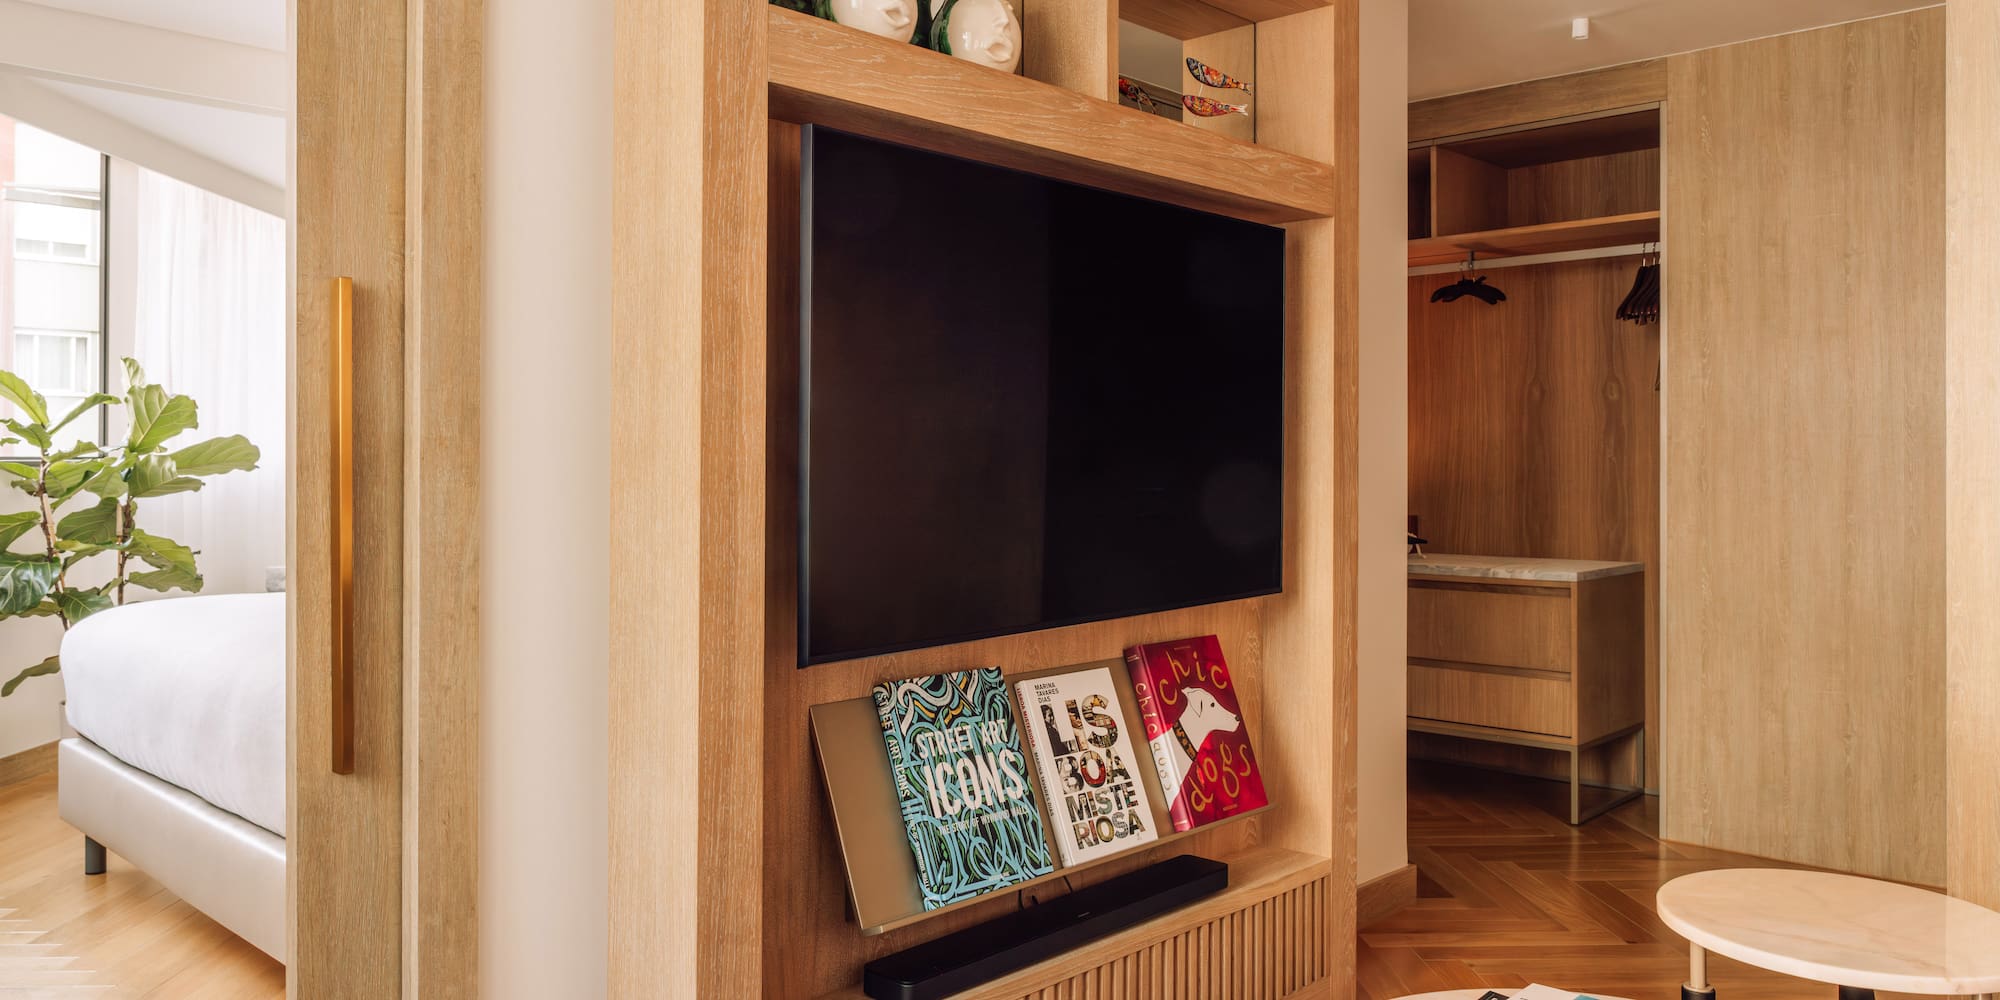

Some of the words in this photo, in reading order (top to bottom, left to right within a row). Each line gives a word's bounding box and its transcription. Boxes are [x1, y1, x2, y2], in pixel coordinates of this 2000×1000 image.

[1034, 682, 1056, 691] MARINA
[1036, 688, 1059, 697] TAVARES
[1159, 651, 1227, 705] chic
[1022, 711, 1036, 748] MISTERIOSA
[1041, 694, 1119, 756] LIS
[1135, 682, 1159, 734] chic
[877, 693, 896, 735] STREET
[888, 739, 902, 763] ART
[895, 764, 911, 798] ICONS
[915, 725, 973, 759] STREET
[981, 719, 1009, 747] ART
[923, 749, 1023, 819] ICONS
[1055, 749, 1131, 794] BOA
[1191, 742, 1251, 812] dogs
[1064, 782, 1139, 823] MISTE
[1073, 809, 1146, 849] RIOSA
